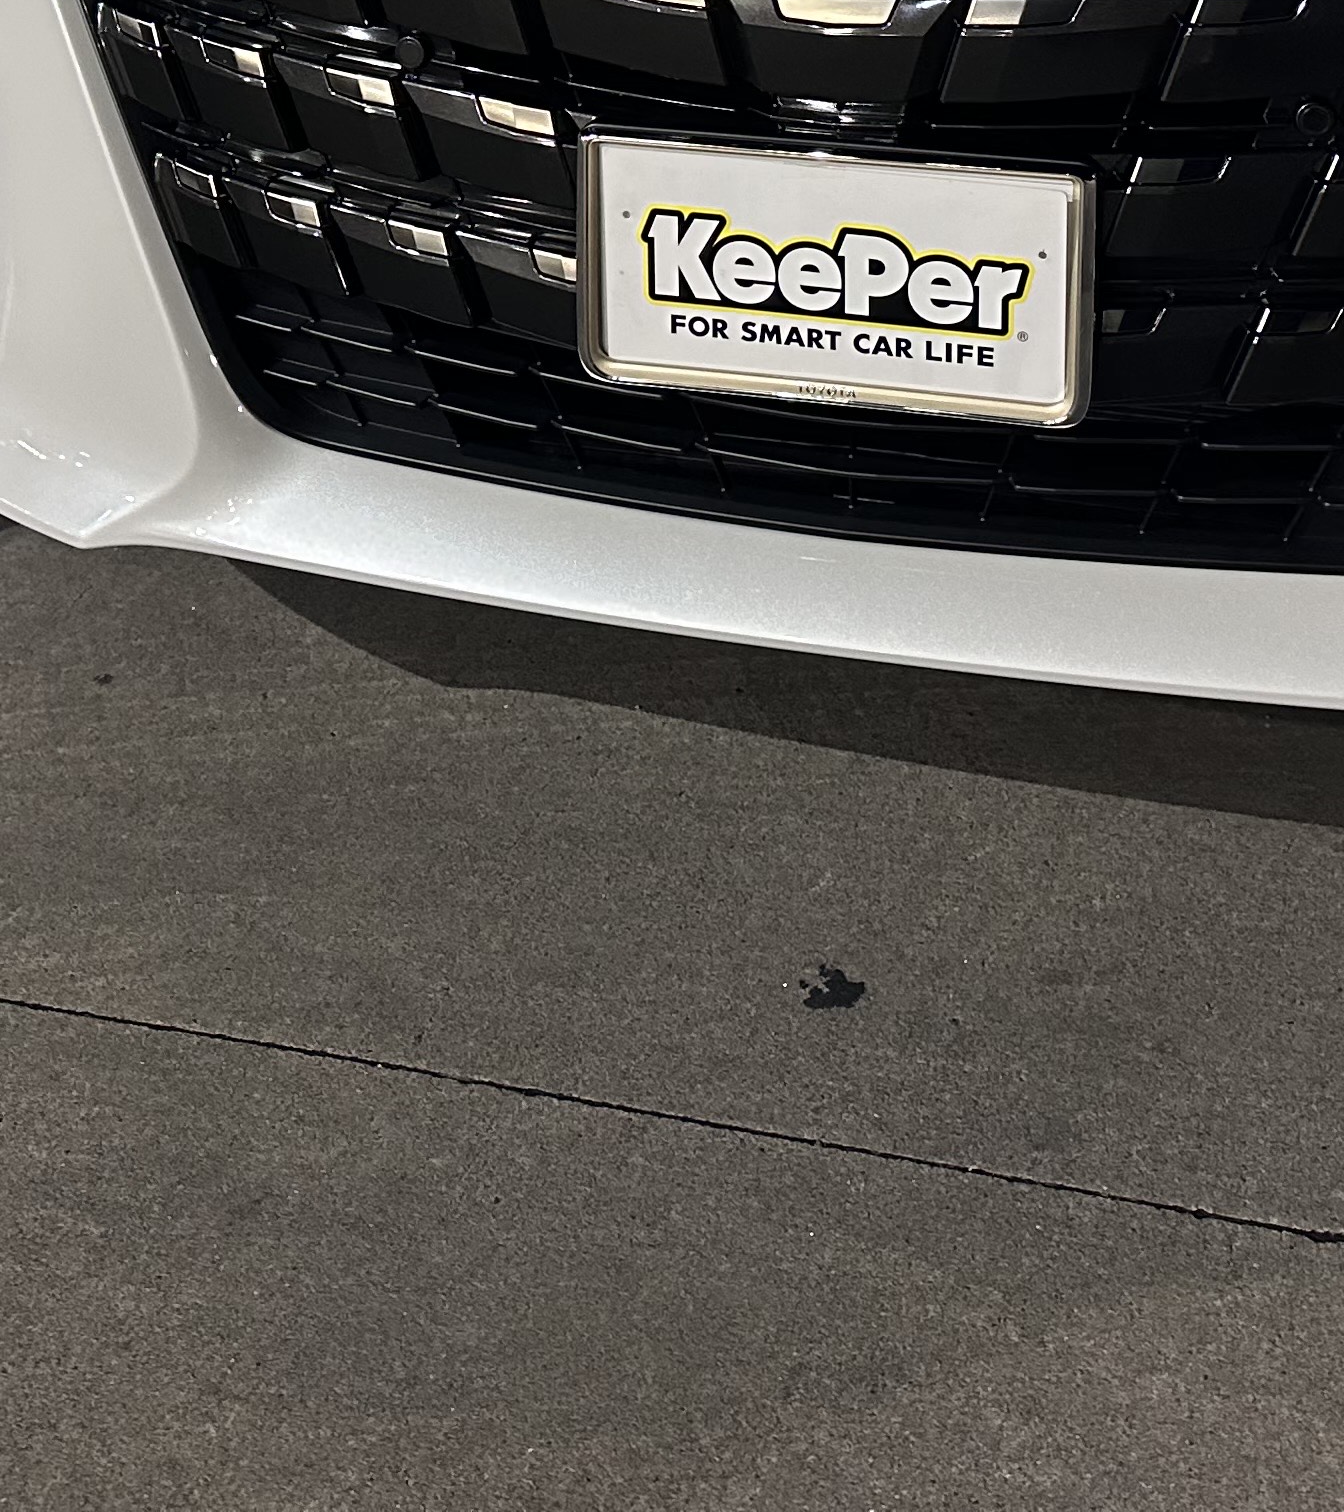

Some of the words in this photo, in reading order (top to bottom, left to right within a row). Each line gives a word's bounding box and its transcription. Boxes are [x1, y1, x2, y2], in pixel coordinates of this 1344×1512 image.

[670, 314, 729, 340] FOR
[741, 321, 842, 351] SMART
[853, 333, 913, 359] CAR
[925, 340, 995, 368] LIFE
